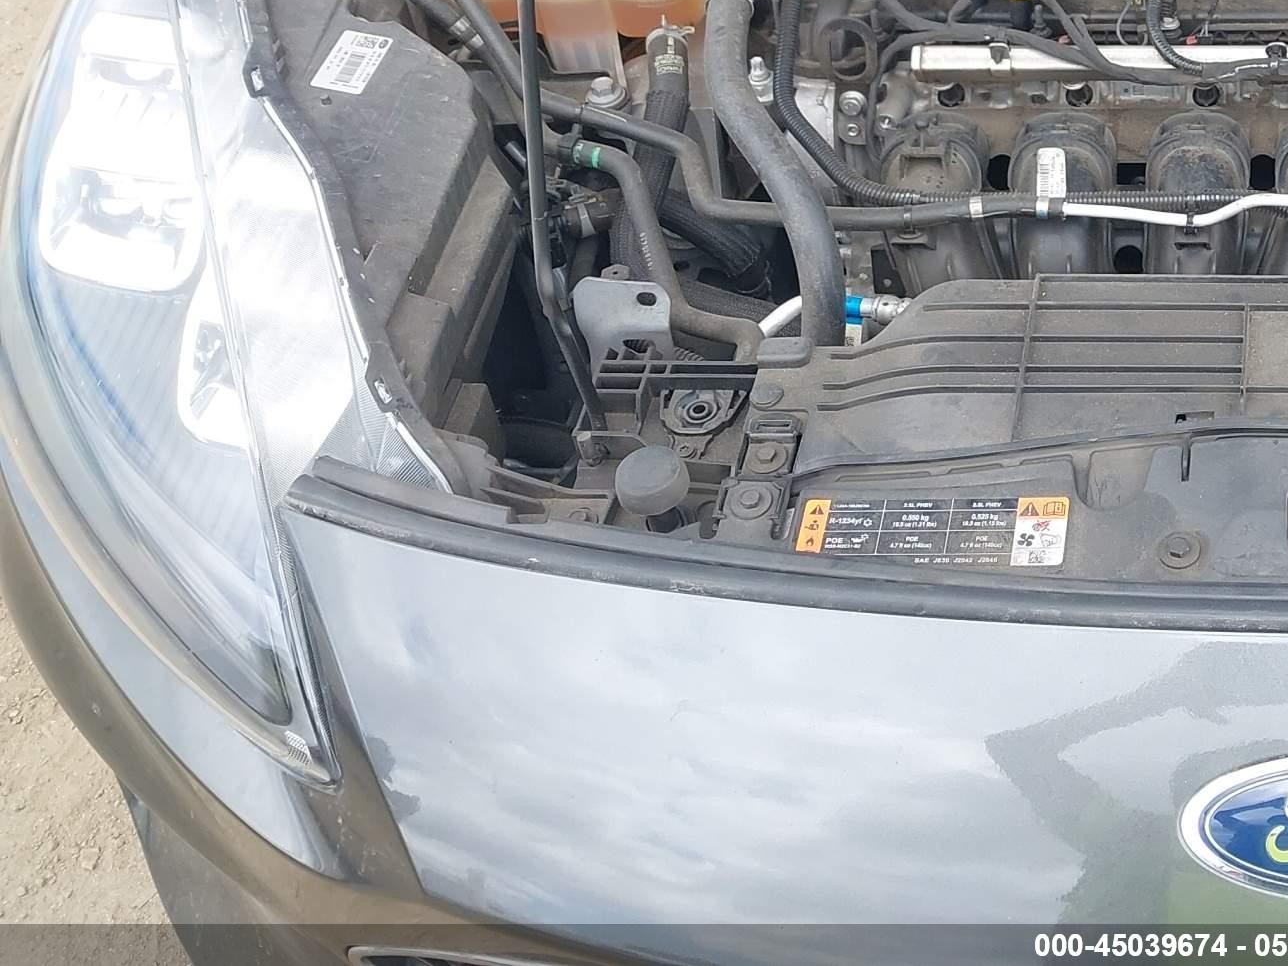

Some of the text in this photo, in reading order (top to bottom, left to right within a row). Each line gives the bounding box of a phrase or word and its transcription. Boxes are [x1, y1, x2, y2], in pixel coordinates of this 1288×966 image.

[828, 517, 863, 526] R-1234yf
[920, 514, 930, 522] kg
[989, 513, 999, 522] kg
